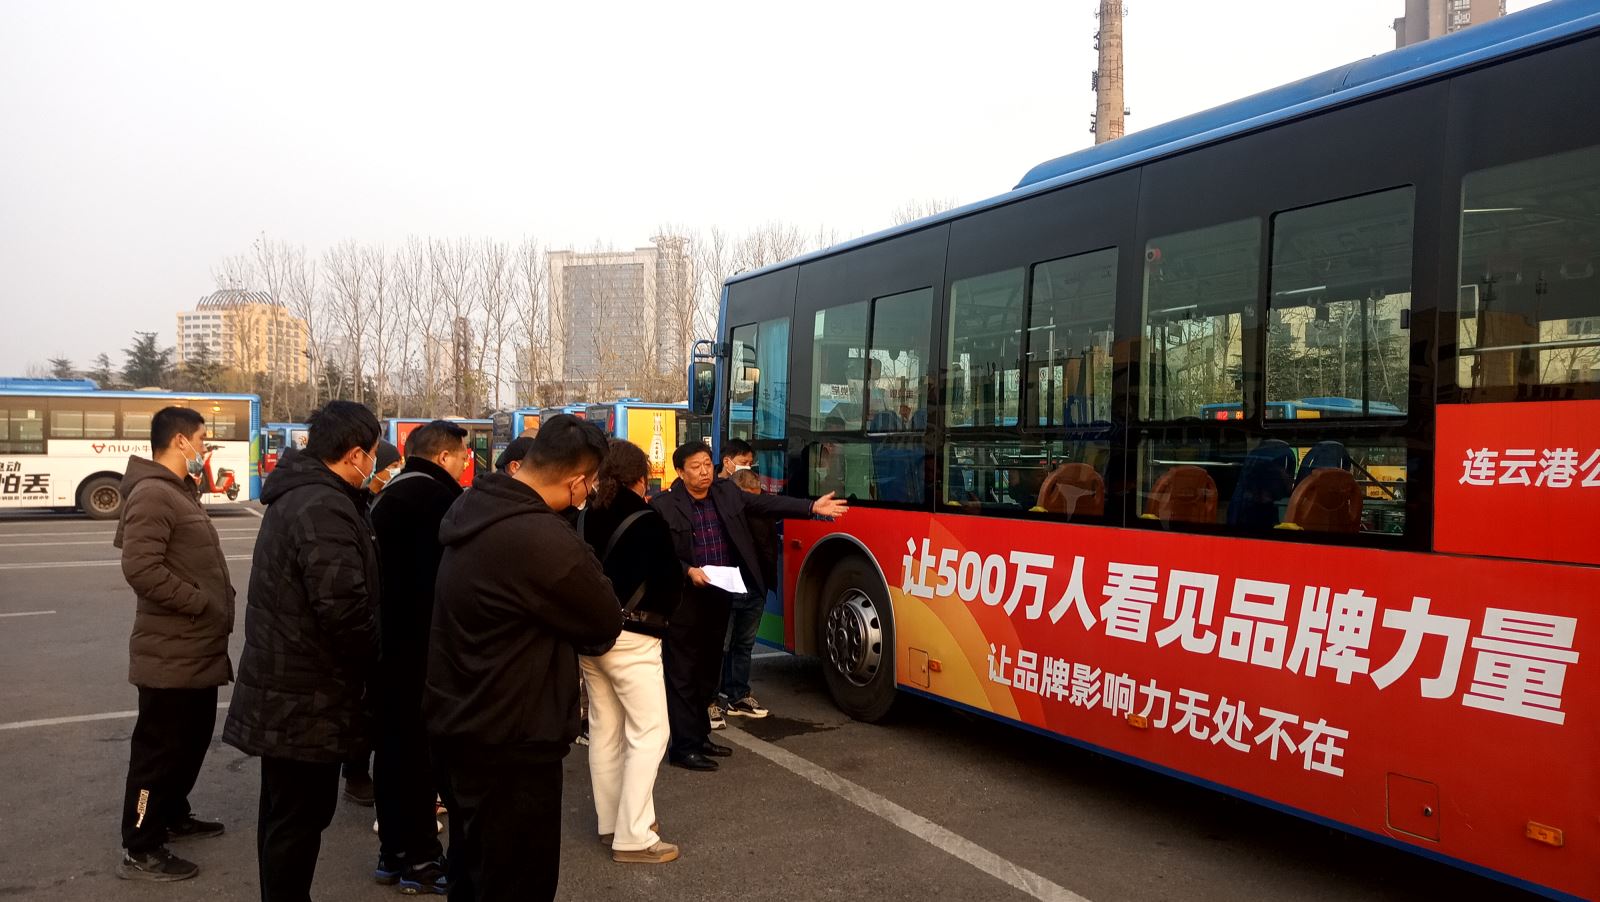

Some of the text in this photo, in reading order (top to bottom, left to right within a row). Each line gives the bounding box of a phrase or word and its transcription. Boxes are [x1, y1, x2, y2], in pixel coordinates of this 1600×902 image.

[902, 537, 1579, 725] 让500万人看见品牌力量
[987, 644, 1349, 777] 让品牌影响力无处不在
